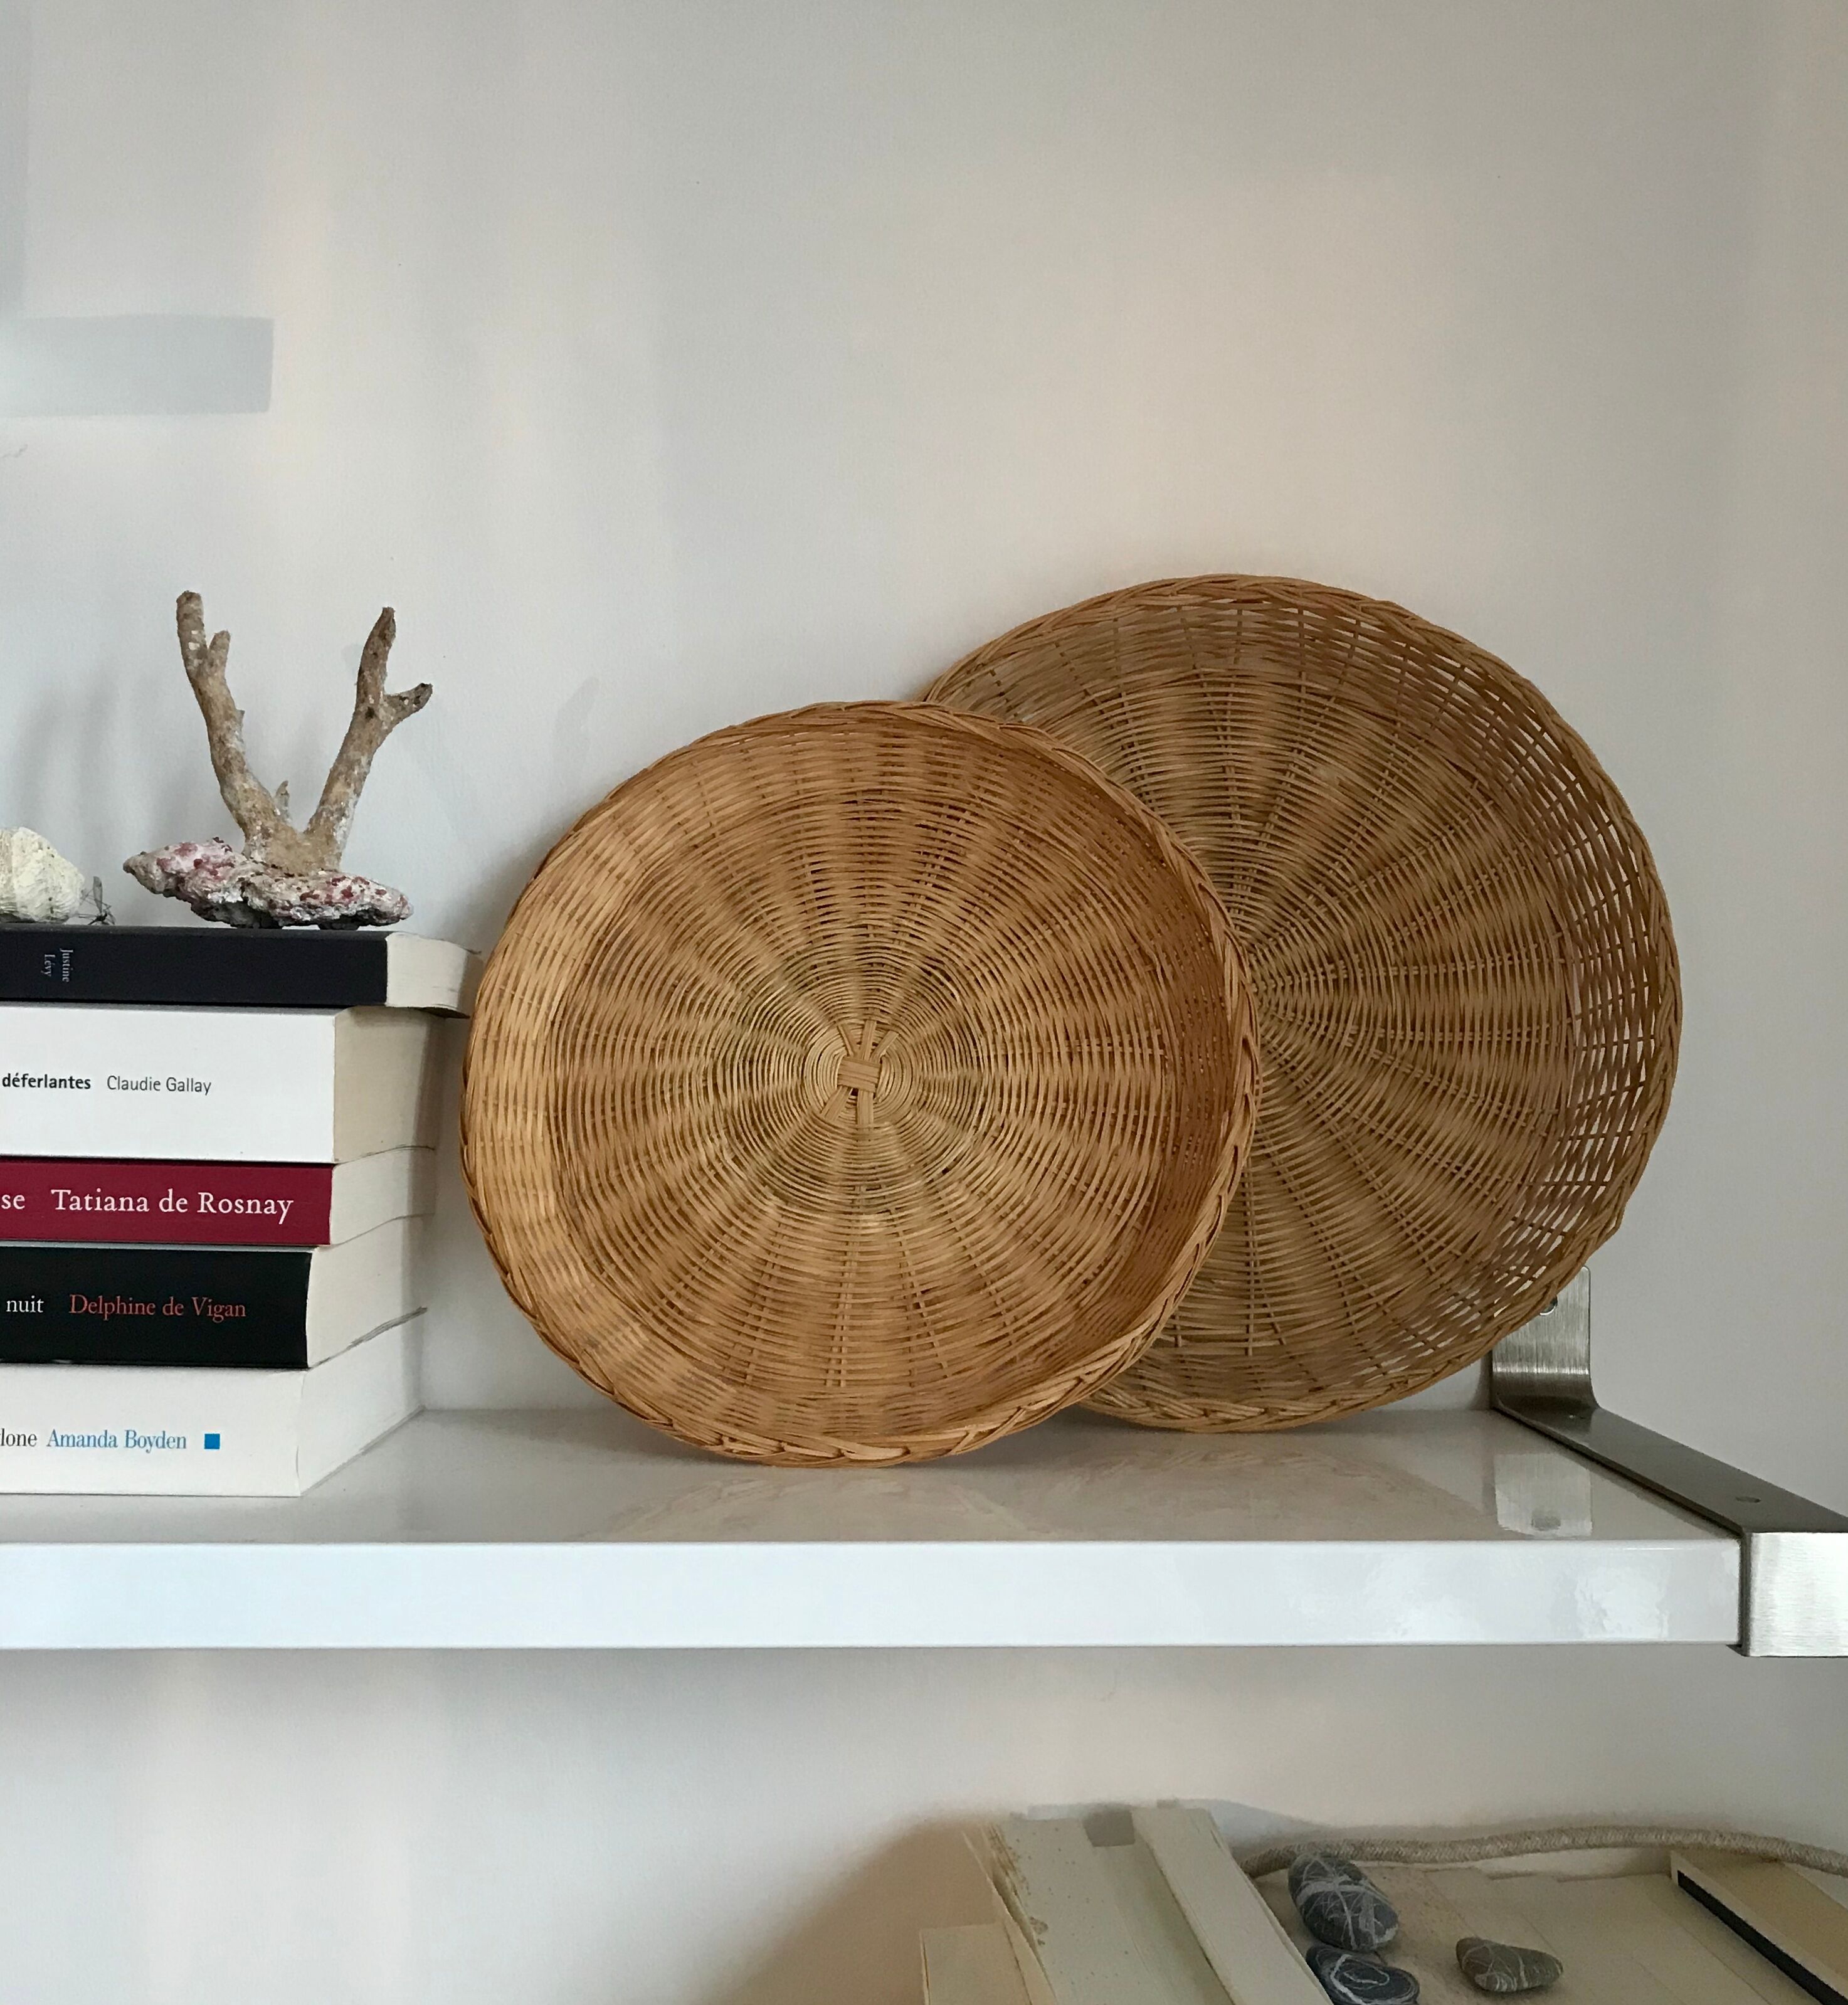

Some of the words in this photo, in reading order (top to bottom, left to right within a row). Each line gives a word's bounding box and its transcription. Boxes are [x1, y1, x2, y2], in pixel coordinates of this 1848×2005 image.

[41, 954, 56, 976] Lévy
[60, 948, 73, 983] Justine
[2, 1072, 91, 1090] déferlantes
[107, 1075, 161, 1091] Claudie
[166, 1077, 212, 1096] Gallay
[1, 1194, 25, 1210] se
[50, 1188, 150, 1212] Tatiana
[159, 1188, 188, 1213] de
[196, 1192, 294, 1225] Rosnay
[6, 1295, 45, 1313] nuit
[68, 1294, 156, 1321] Delphine
[162, 1296, 184, 1316] de
[191, 1296, 246, 1323] Vigan
[0, 1427, 38, 1447] lone
[46, 1429, 119, 1448] Amanda
[125, 1429, 186, 1454] Boyden
